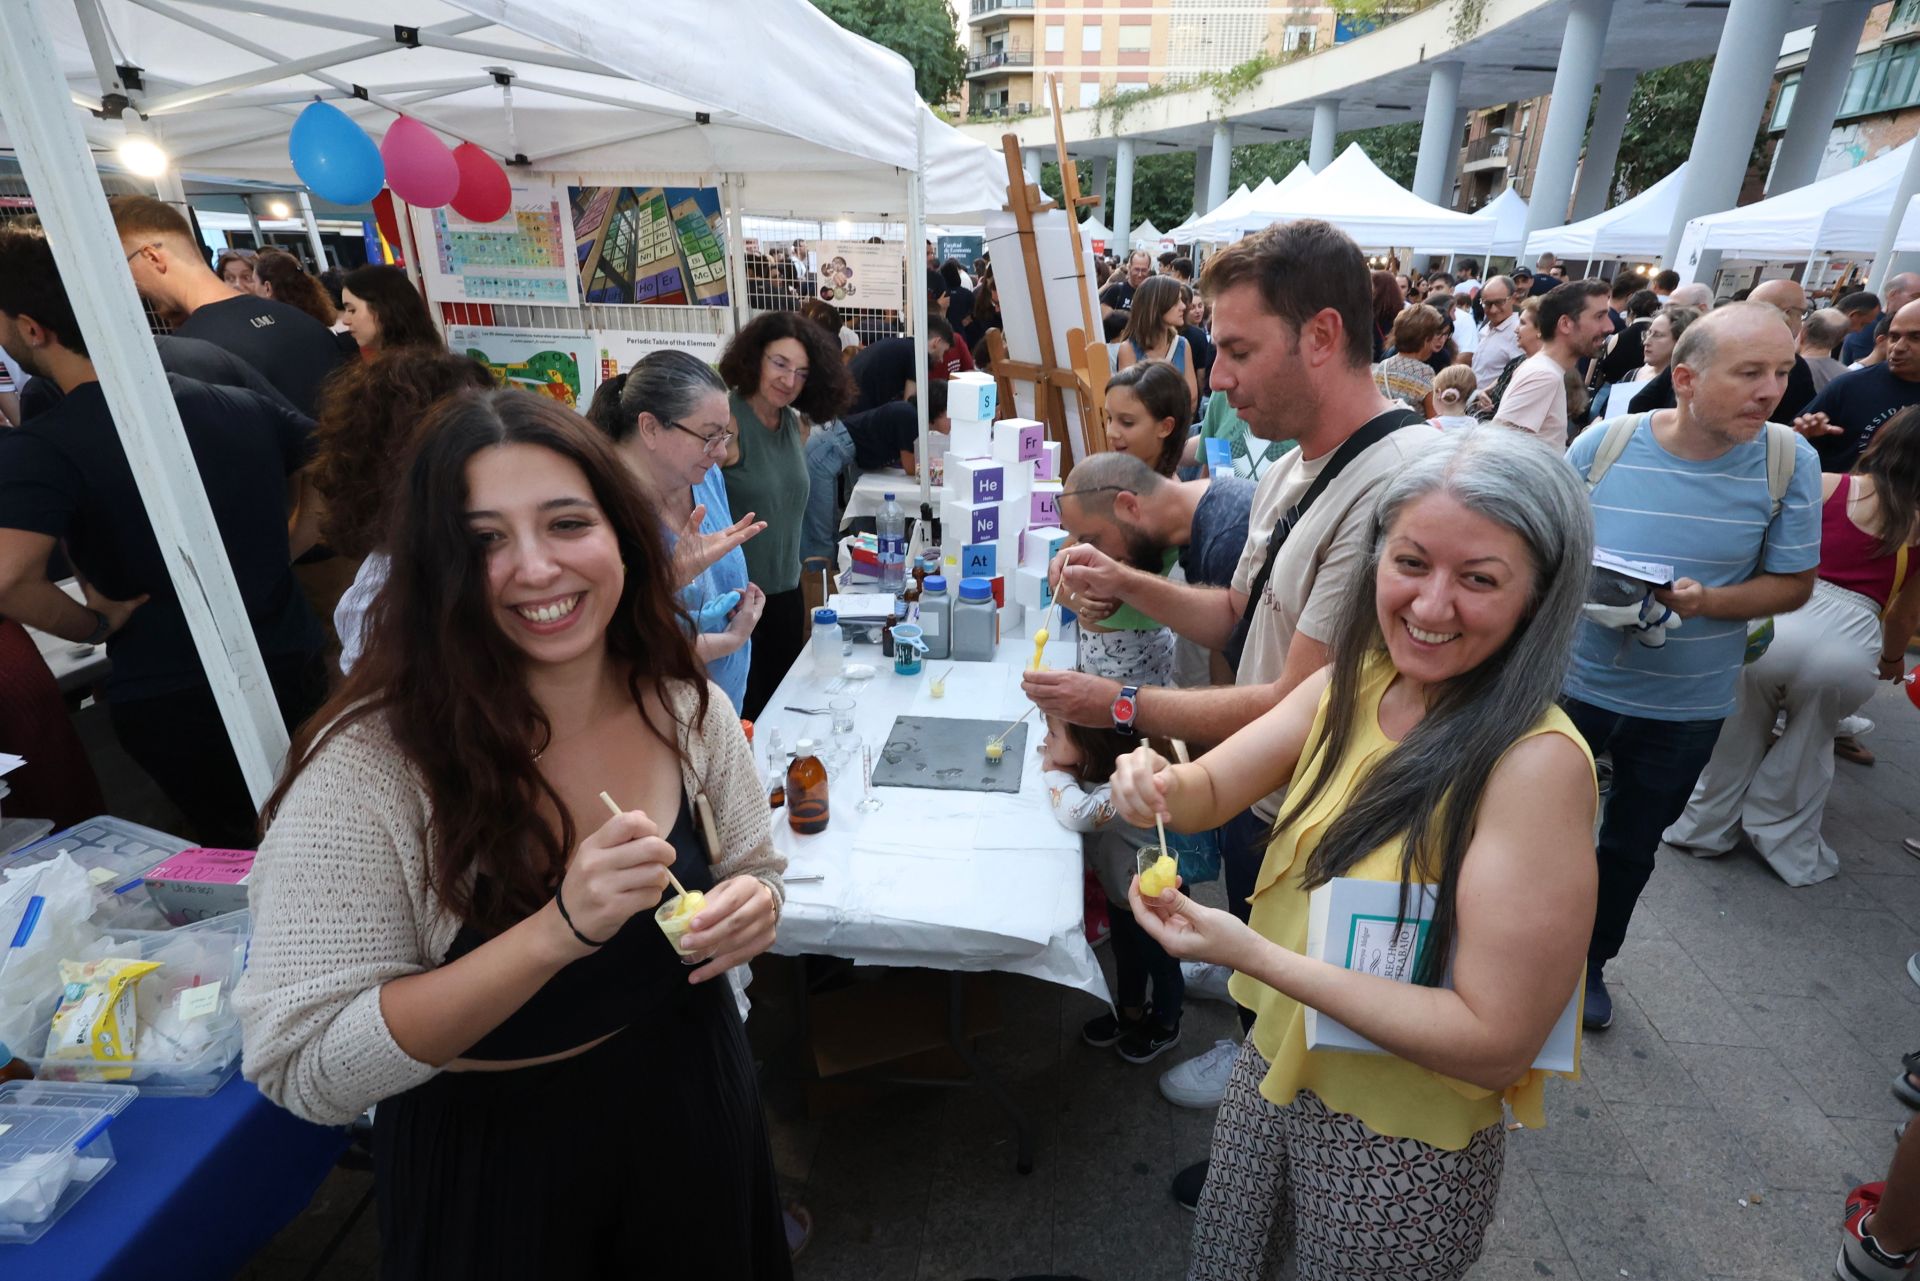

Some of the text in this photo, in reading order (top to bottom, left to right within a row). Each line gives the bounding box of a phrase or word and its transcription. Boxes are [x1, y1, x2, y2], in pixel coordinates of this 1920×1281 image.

[640, 252, 652, 262] Nh
[662, 275, 673, 286] Er
[693, 271, 709, 280] Mc
[639, 283, 654, 293] Ho
[626, 337, 651, 345] Periodic
[652, 338, 669, 346] Table
[686, 339, 716, 348] Elements
[984, 395, 990, 408] S
[1025, 437, 1037, 449] Fr
[979, 479, 998, 493] He
[1041, 501, 1053, 513] Li
[977, 519, 994, 532] Ne
[971, 555, 988, 567] At
[1384, 940, 1398, 981] RECHO
[1394, 931, 1410, 982] TRABAJO
